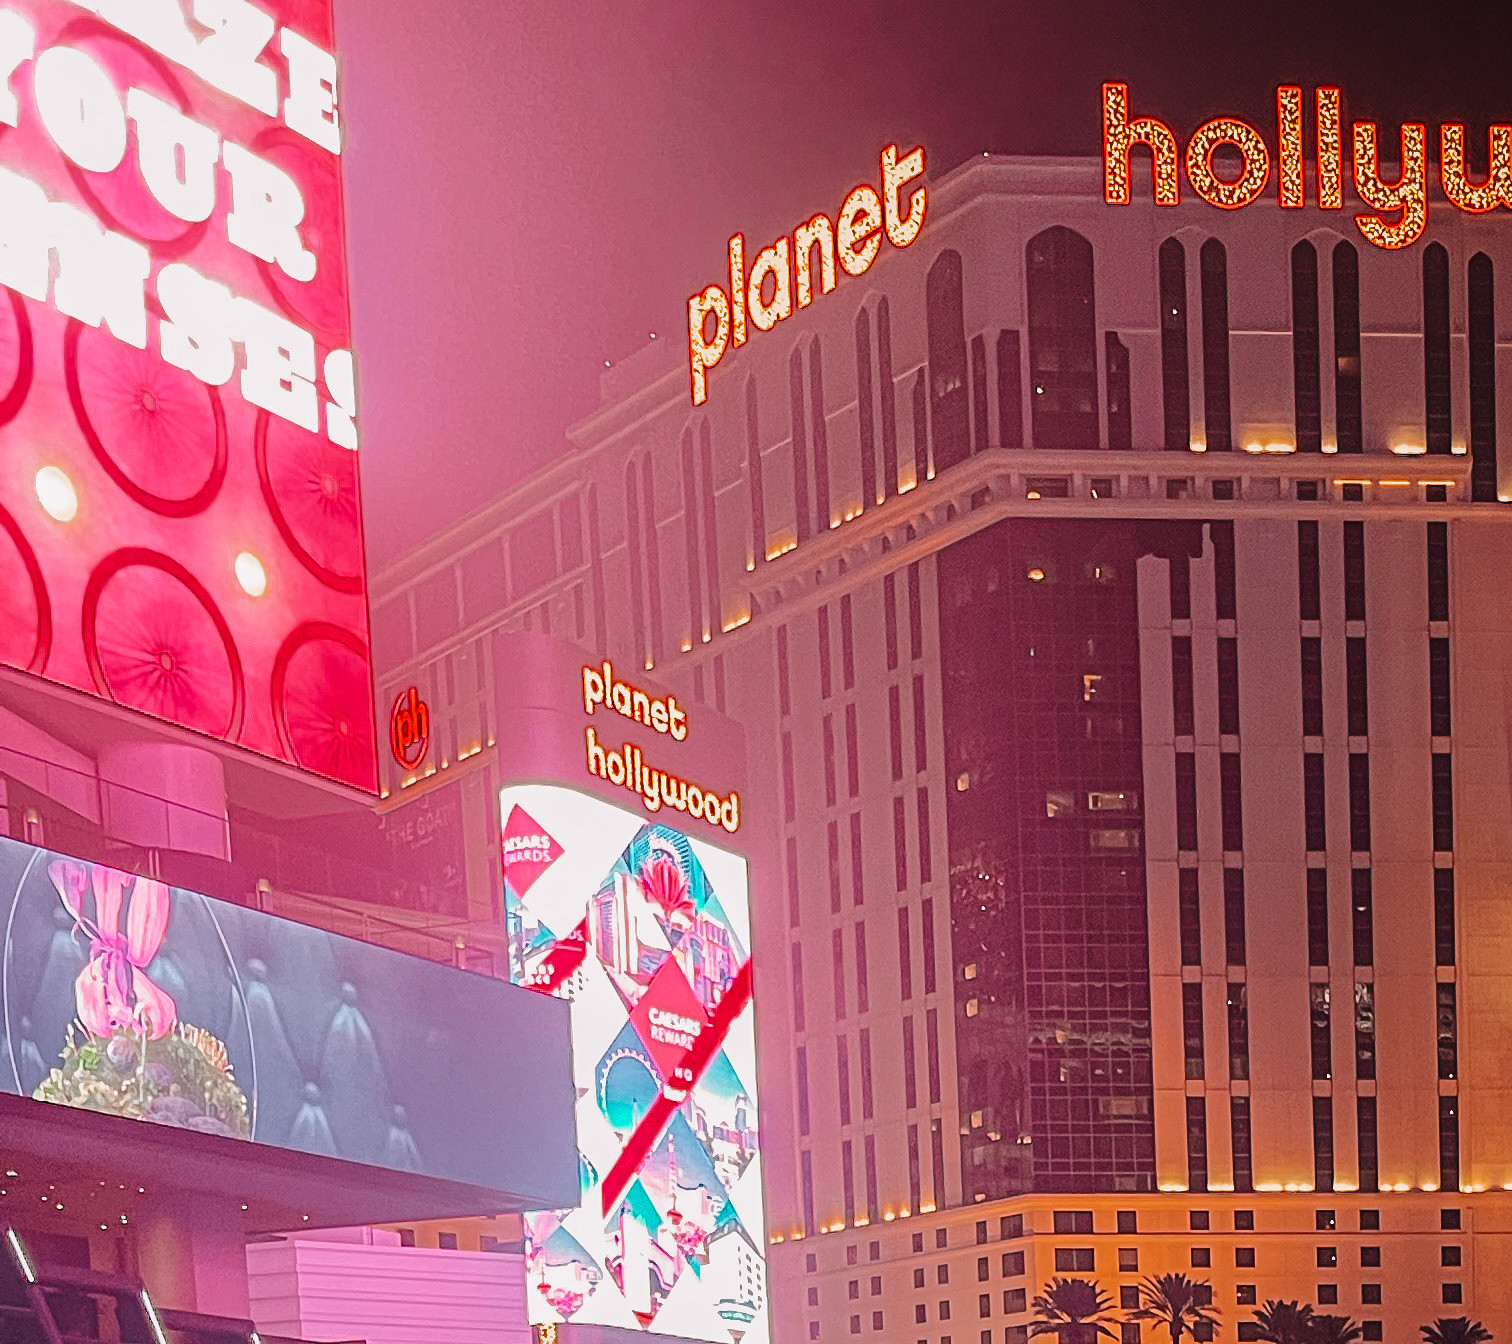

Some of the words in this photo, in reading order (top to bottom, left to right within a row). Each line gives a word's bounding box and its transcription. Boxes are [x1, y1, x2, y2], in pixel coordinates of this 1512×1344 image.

[687, 143, 928, 407] planet
[582, 659, 687, 741] planet
[586, 726, 740, 832] hollywood
